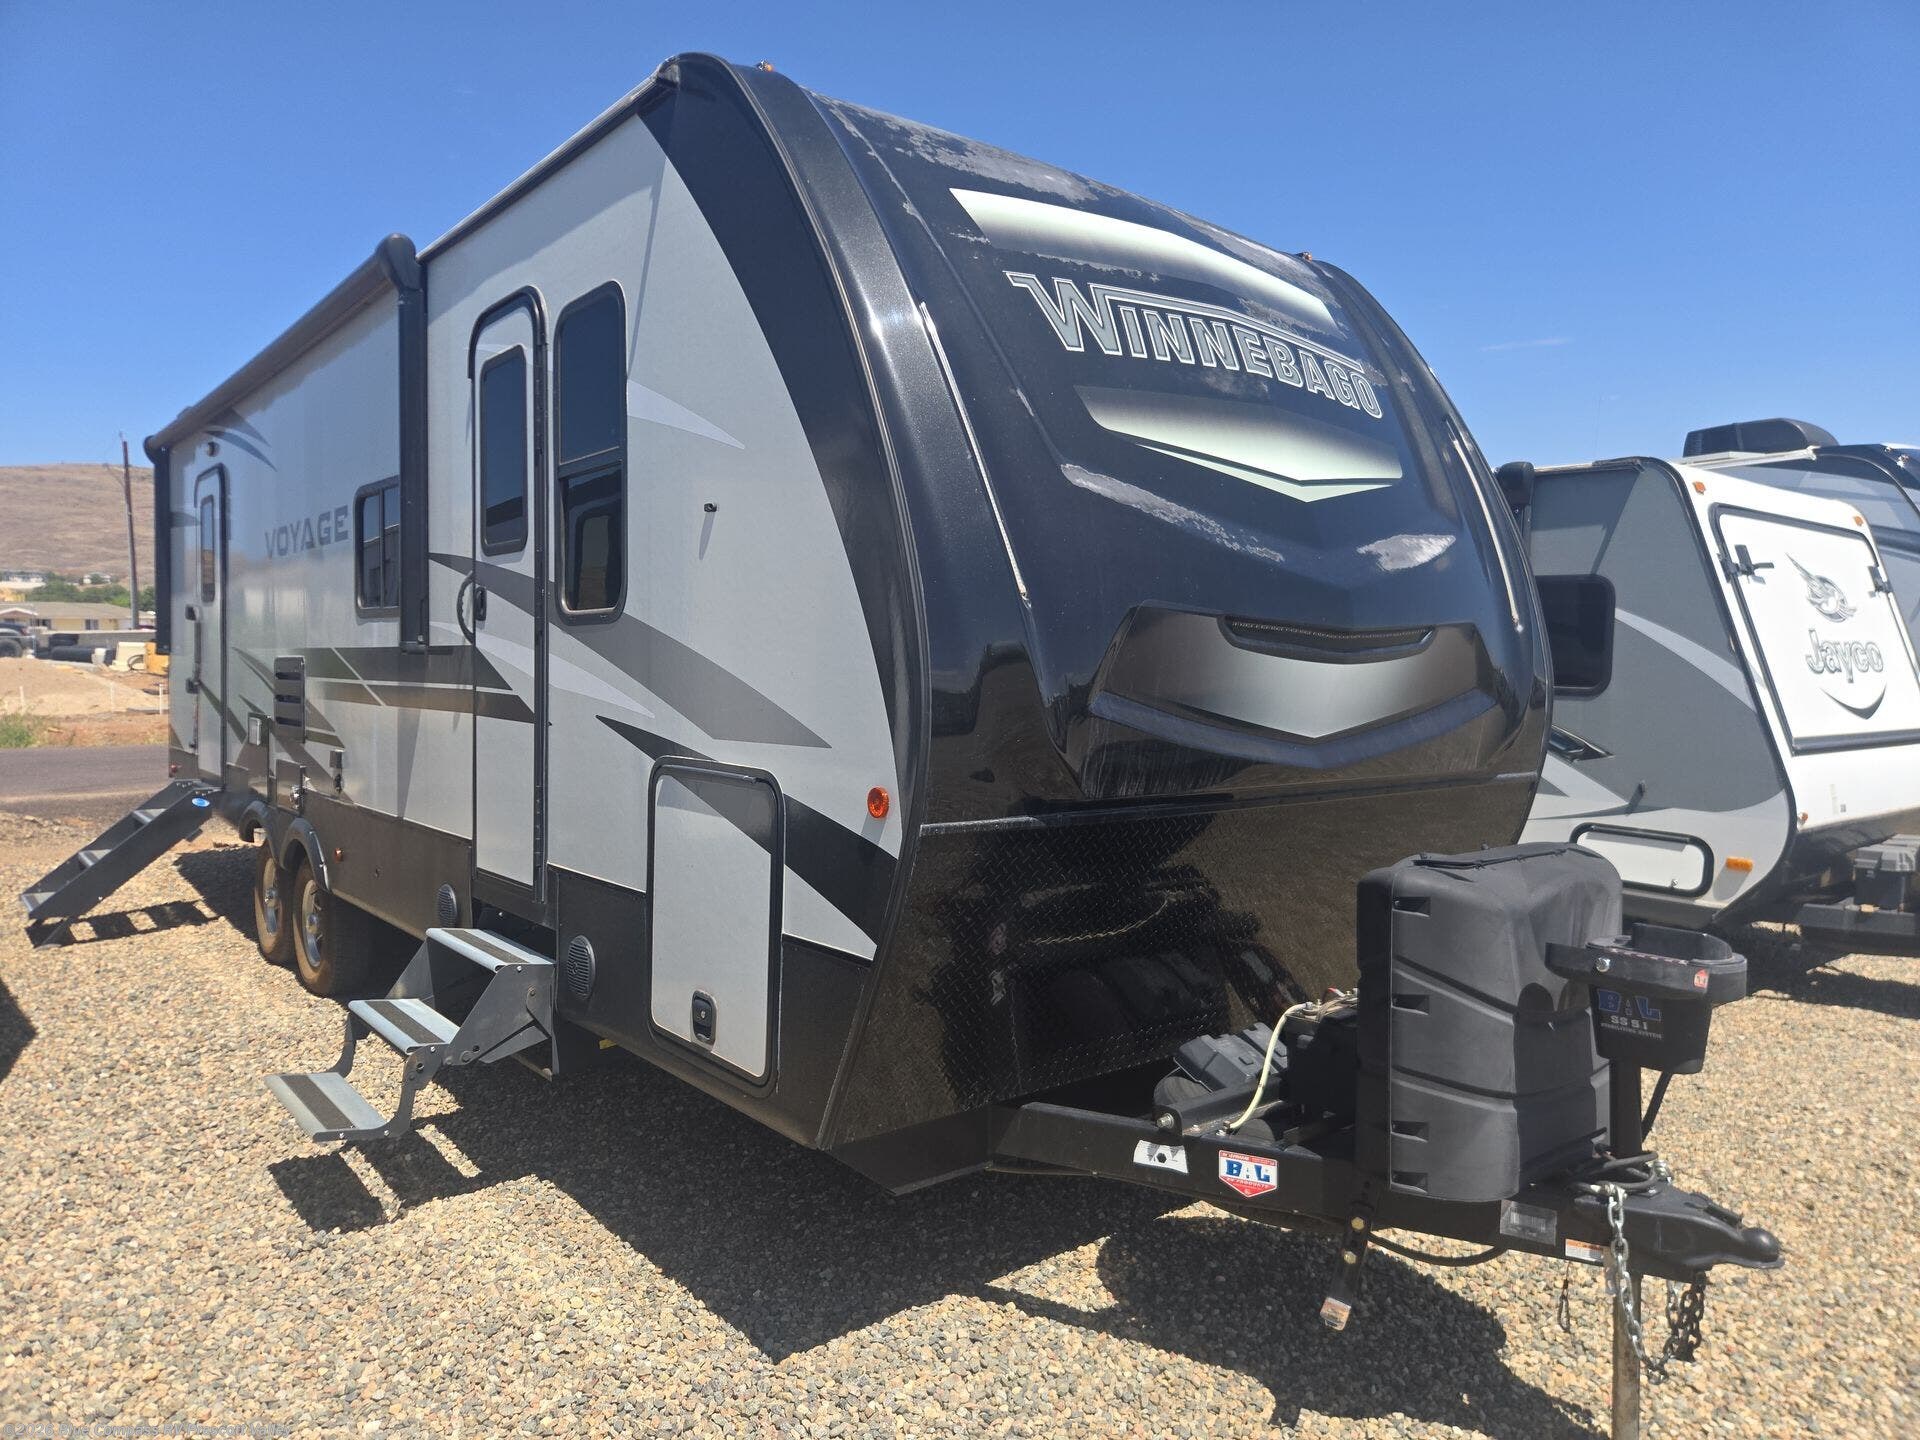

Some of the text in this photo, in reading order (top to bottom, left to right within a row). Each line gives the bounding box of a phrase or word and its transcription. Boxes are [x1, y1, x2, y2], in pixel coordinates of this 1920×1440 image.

[1003, 270, 1383, 419] WINNEBAGO
[264, 505, 350, 559] VOYAGE
[1804, 628, 1885, 684] Jayco
